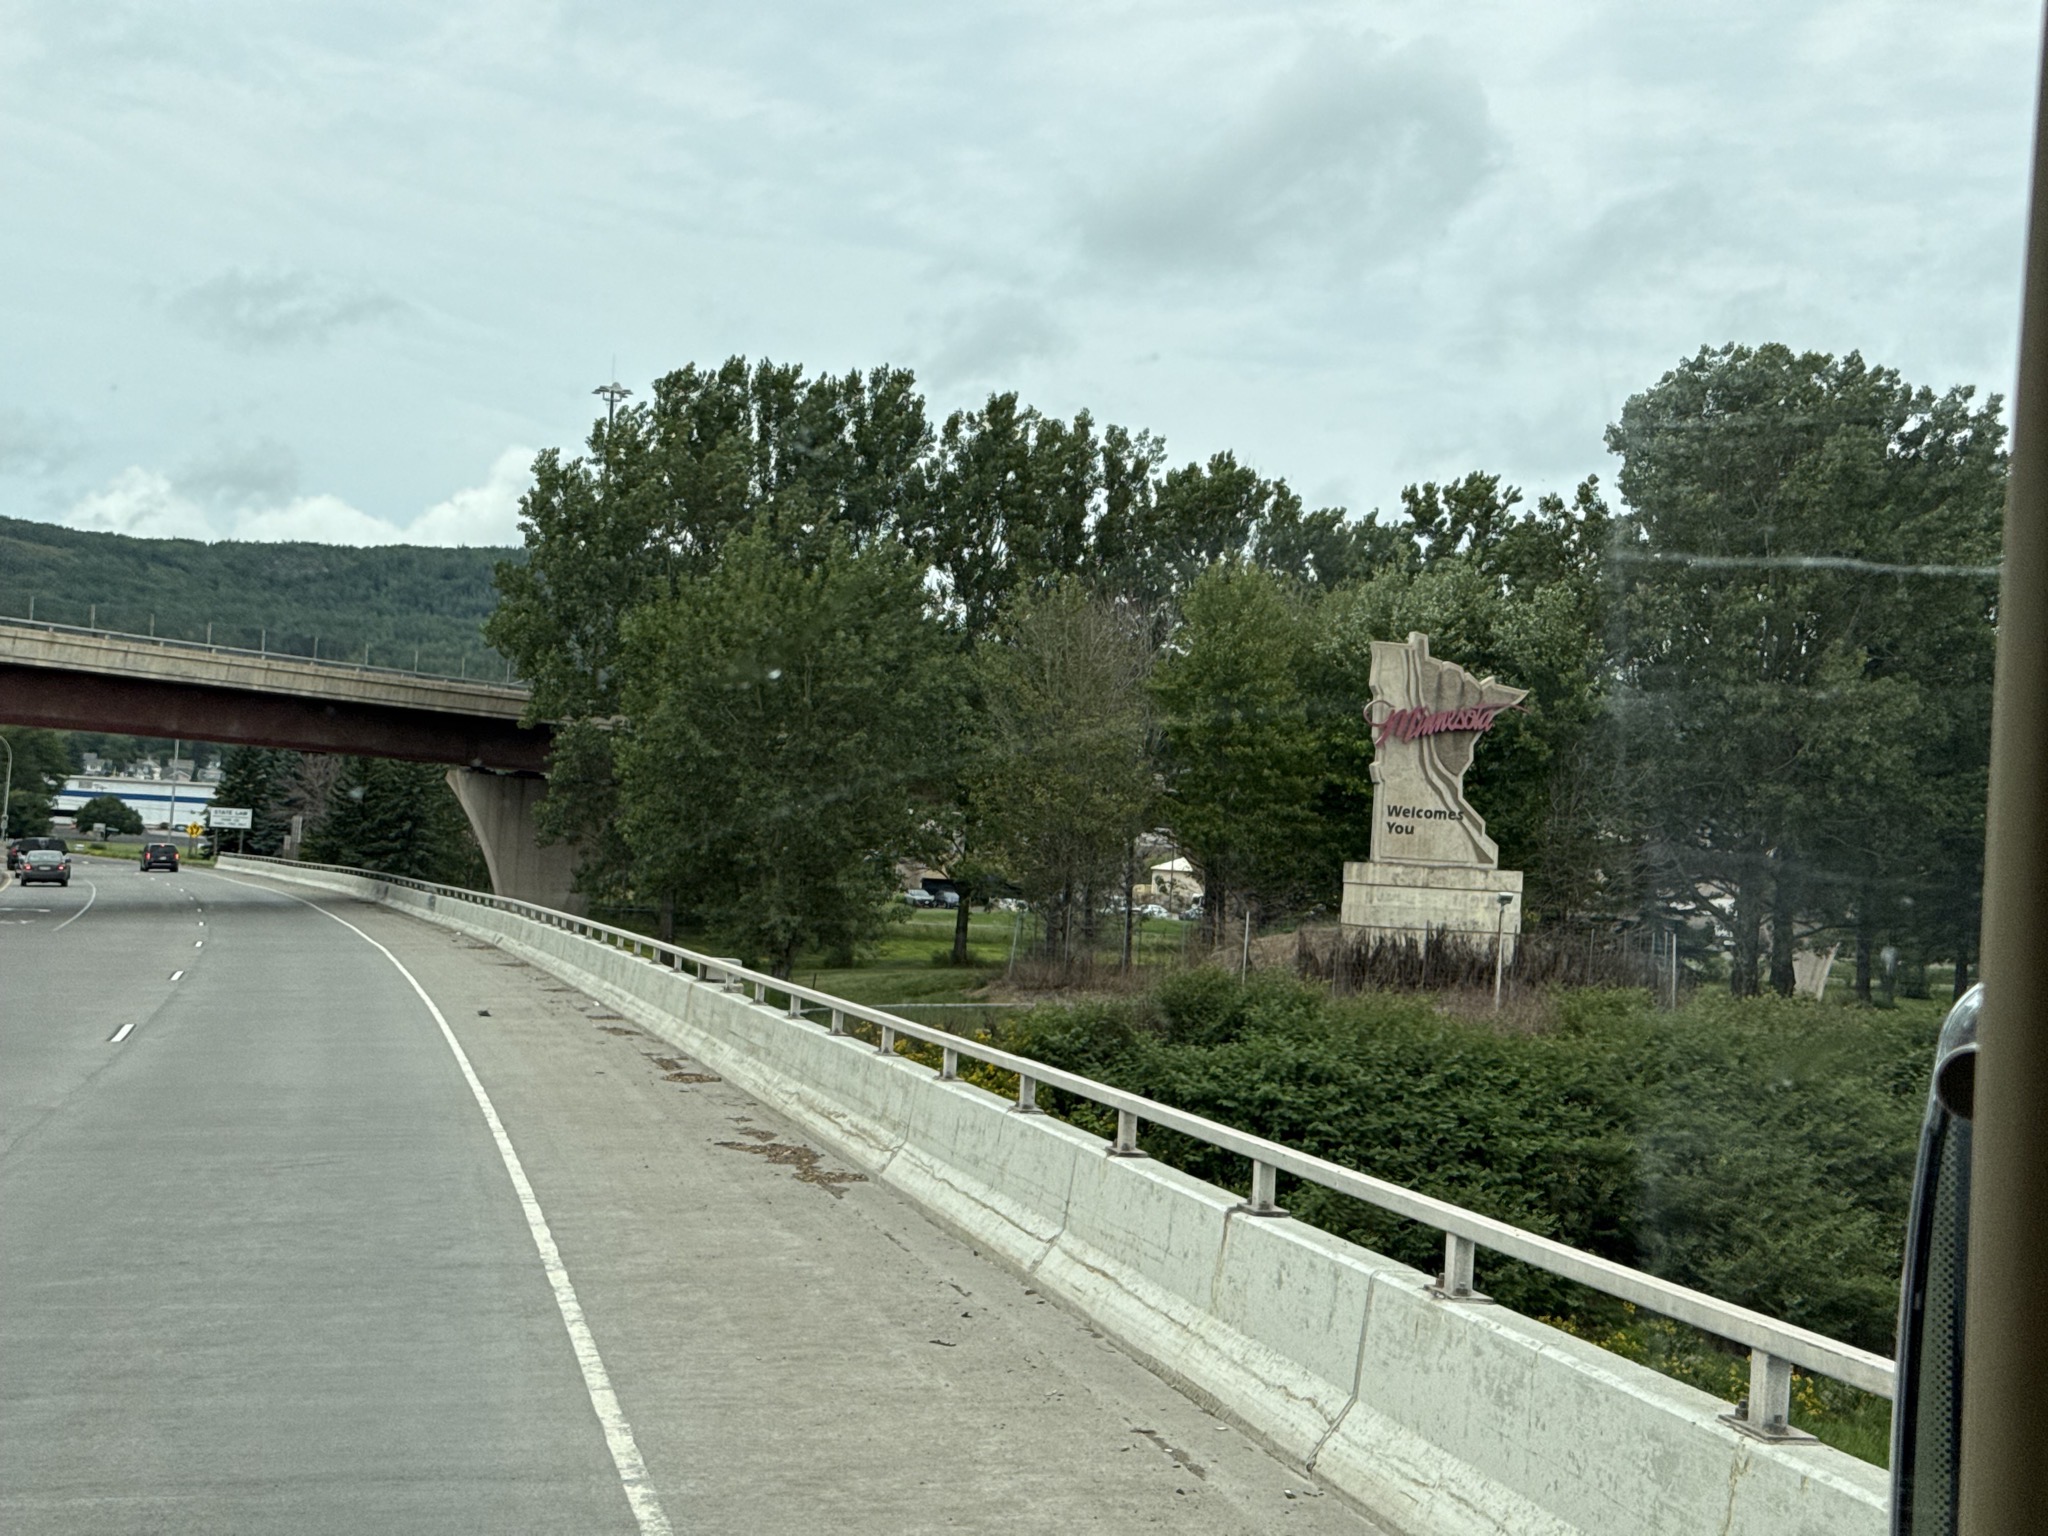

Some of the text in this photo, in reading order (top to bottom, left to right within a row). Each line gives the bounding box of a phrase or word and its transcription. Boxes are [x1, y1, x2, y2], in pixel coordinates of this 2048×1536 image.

[1363, 699, 1530, 747] Minnesota
[1387, 805, 1464, 821] Welcomes
[1386, 821, 1415, 836] You
